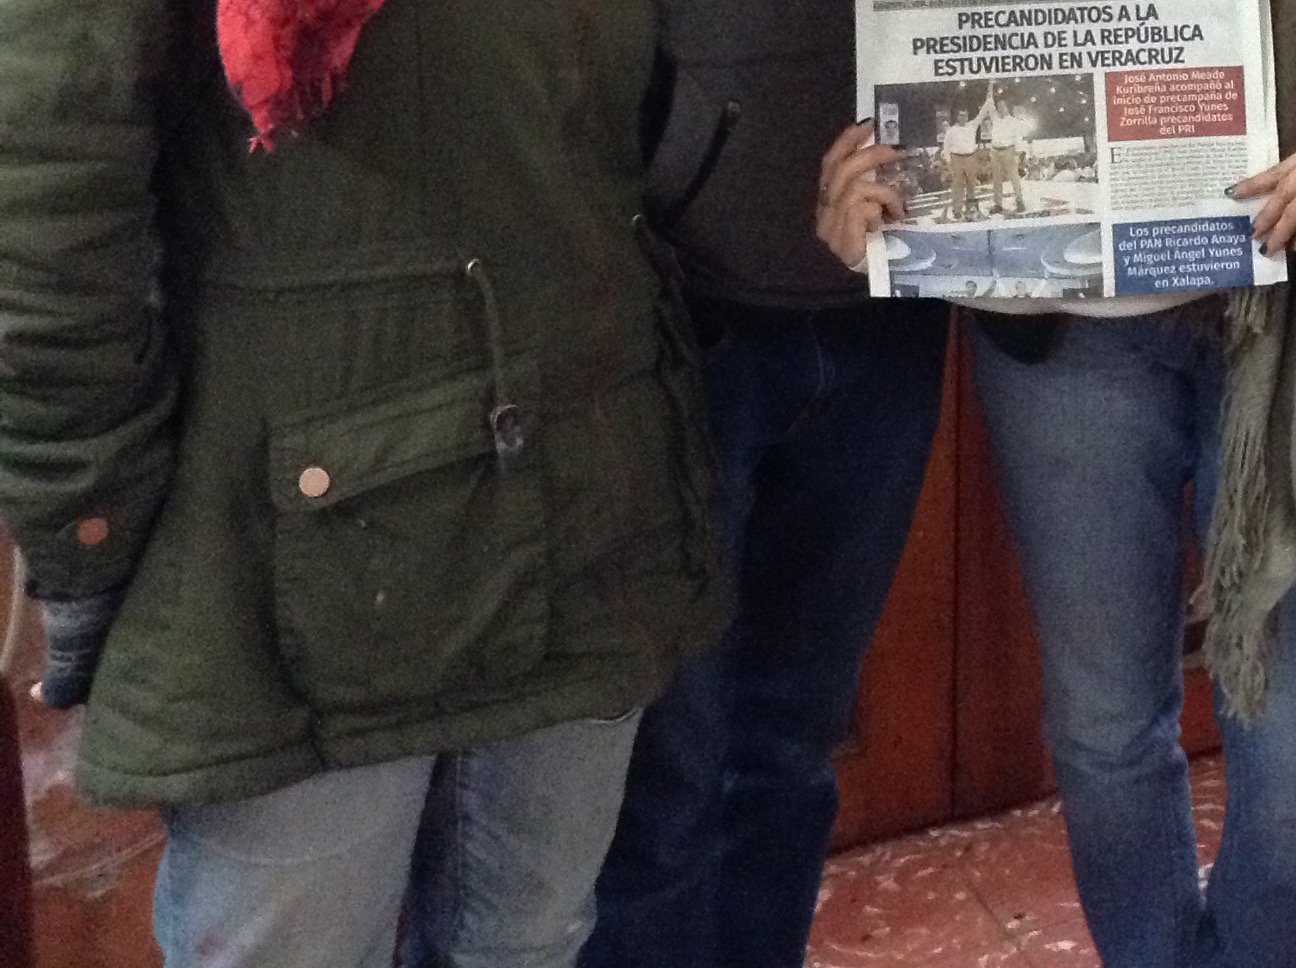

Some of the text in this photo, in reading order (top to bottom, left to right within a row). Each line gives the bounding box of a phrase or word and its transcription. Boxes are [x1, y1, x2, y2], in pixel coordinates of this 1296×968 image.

[958, 3, 1159, 30] PRECANDIDATOS A LA
[912, 20, 1204, 55] PRESIDENCIA DE LA REPÚBLICA
[934, 46, 1185, 77] ESTUVIERON EN VERACRUZ
[1124, 70, 1225, 84] José Antonio Meade
[1169, 81, 1222, 94] acompañó
[1224, 80, 1234, 89] al
[1113, 91, 1238, 105] inicio de precampaña de
[1124, 102, 1229, 116] José Francisco Yunes
[1120, 112, 1233, 127] Zorrilla precandidatos
[1159, 124, 1195, 135] del PRI
[1129, 221, 1234, 237] Los precandidatos
[1118, 233, 1247, 251] del PAN Ricardo Anaya
[1123, 256, 1131, 266] y
[1133, 250, 1171, 264] Miguel
[1208, 247, 1243, 257] Yunes
[1127, 261, 1240, 278] Márquez estuvieron
[1155, 275, 1214, 288] en Xalapa.
